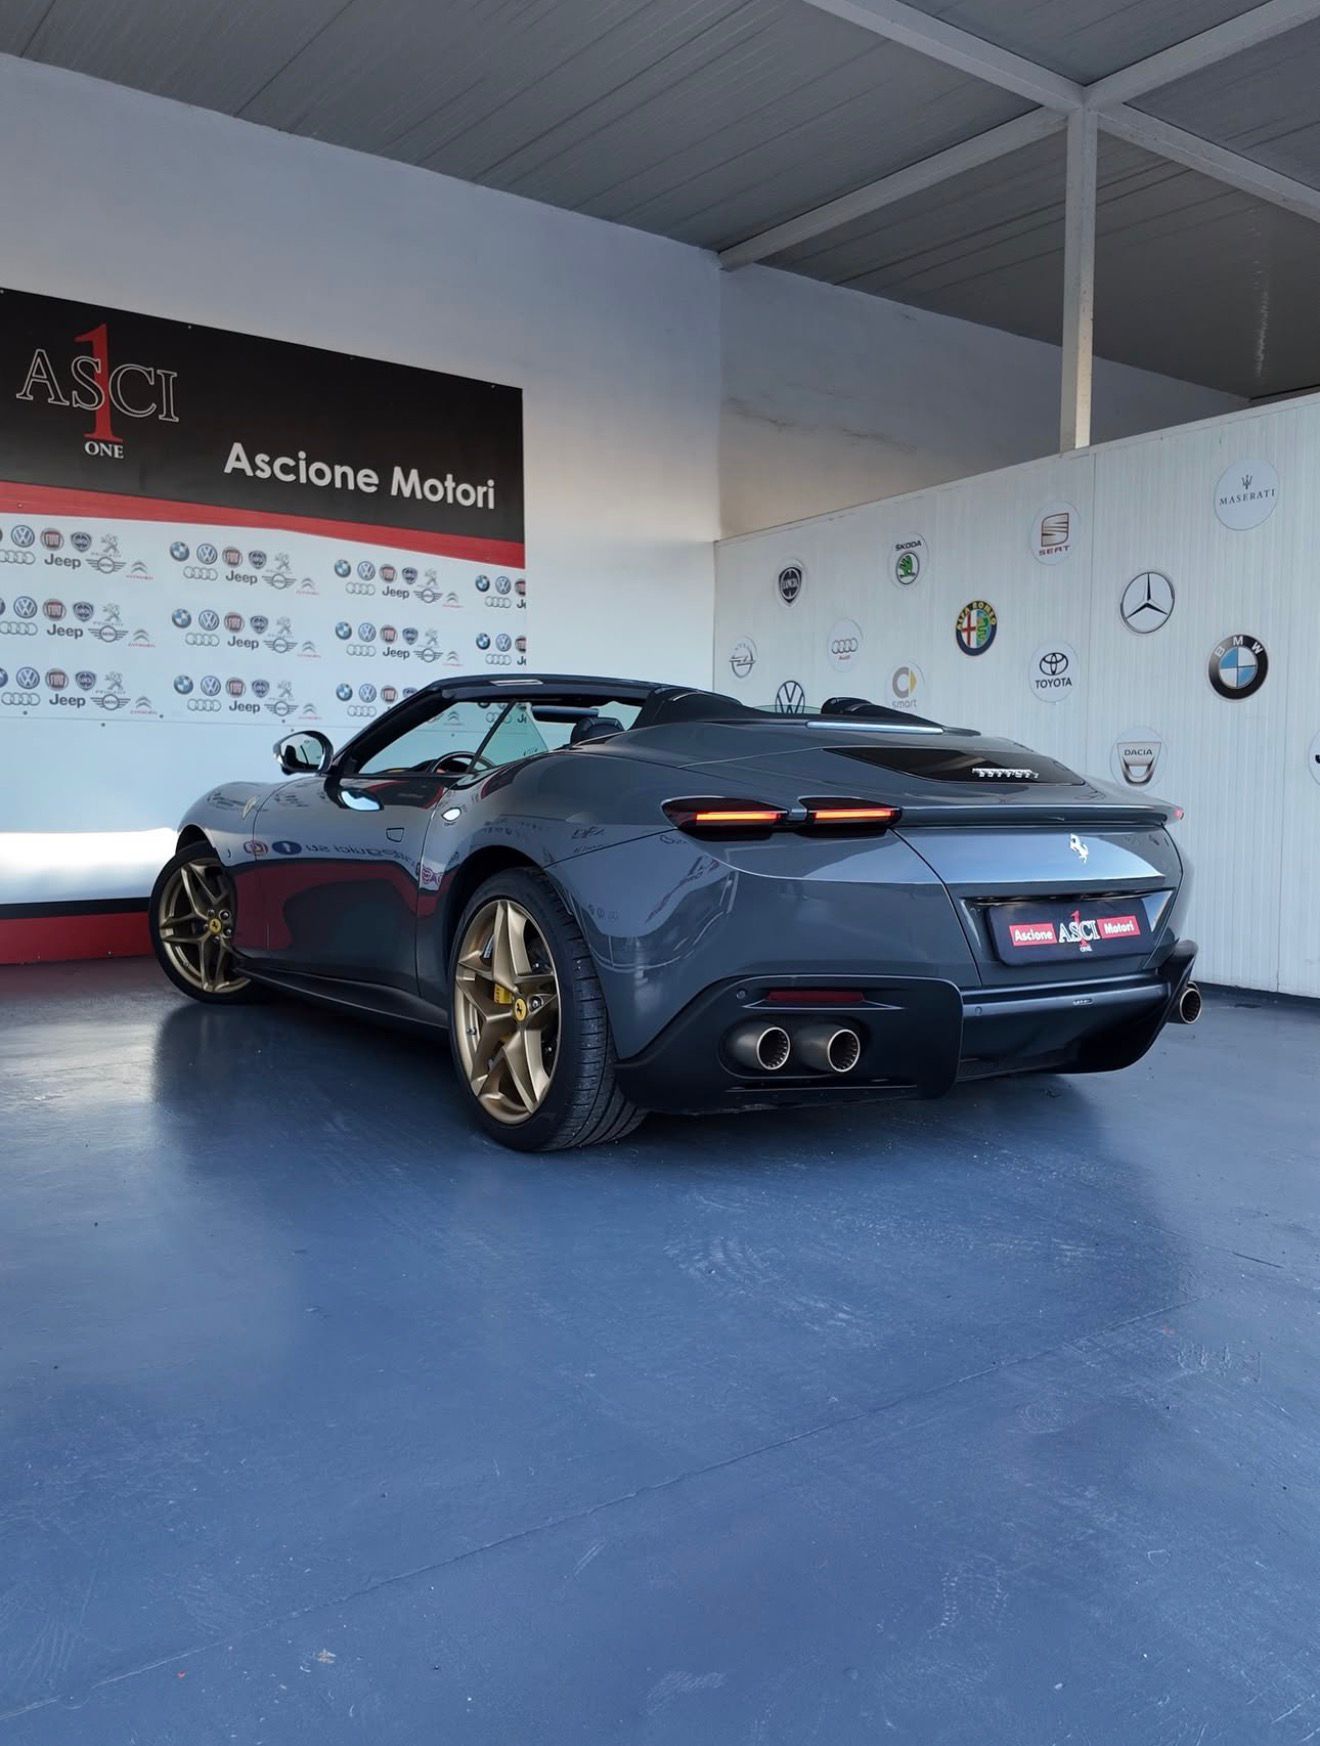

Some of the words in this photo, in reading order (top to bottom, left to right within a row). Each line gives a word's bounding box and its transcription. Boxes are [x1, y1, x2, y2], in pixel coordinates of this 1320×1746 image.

[16, 348, 179, 422] ASCI
[85, 441, 124, 459] ONE
[224, 442, 379, 493] Ascione
[391, 466, 494, 509] Motori
[1219, 488, 1275, 505] MASERATI
[1039, 545, 1070, 556] SEAT
[44, 553, 81, 569] Jeep
[226, 570, 258, 585] Jeep
[382, 586, 410, 599] Jeep
[47, 624, 84, 640] Jeep
[227, 636, 259, 650] Jeep
[1214, 635, 1264, 658] BMW
[382, 647, 410, 660] Jeep
[1035, 677, 1072, 689] TOYOTA
[49, 694, 86, 709] Jeep
[229, 701, 260, 714] Jeep
[892, 699, 917, 709] smart
[1123, 748, 1153, 756] DACIA
[1014, 929, 1053, 942] Ascione
[1059, 920, 1100, 943] ASCI
[1103, 920, 1135, 934] Motori
